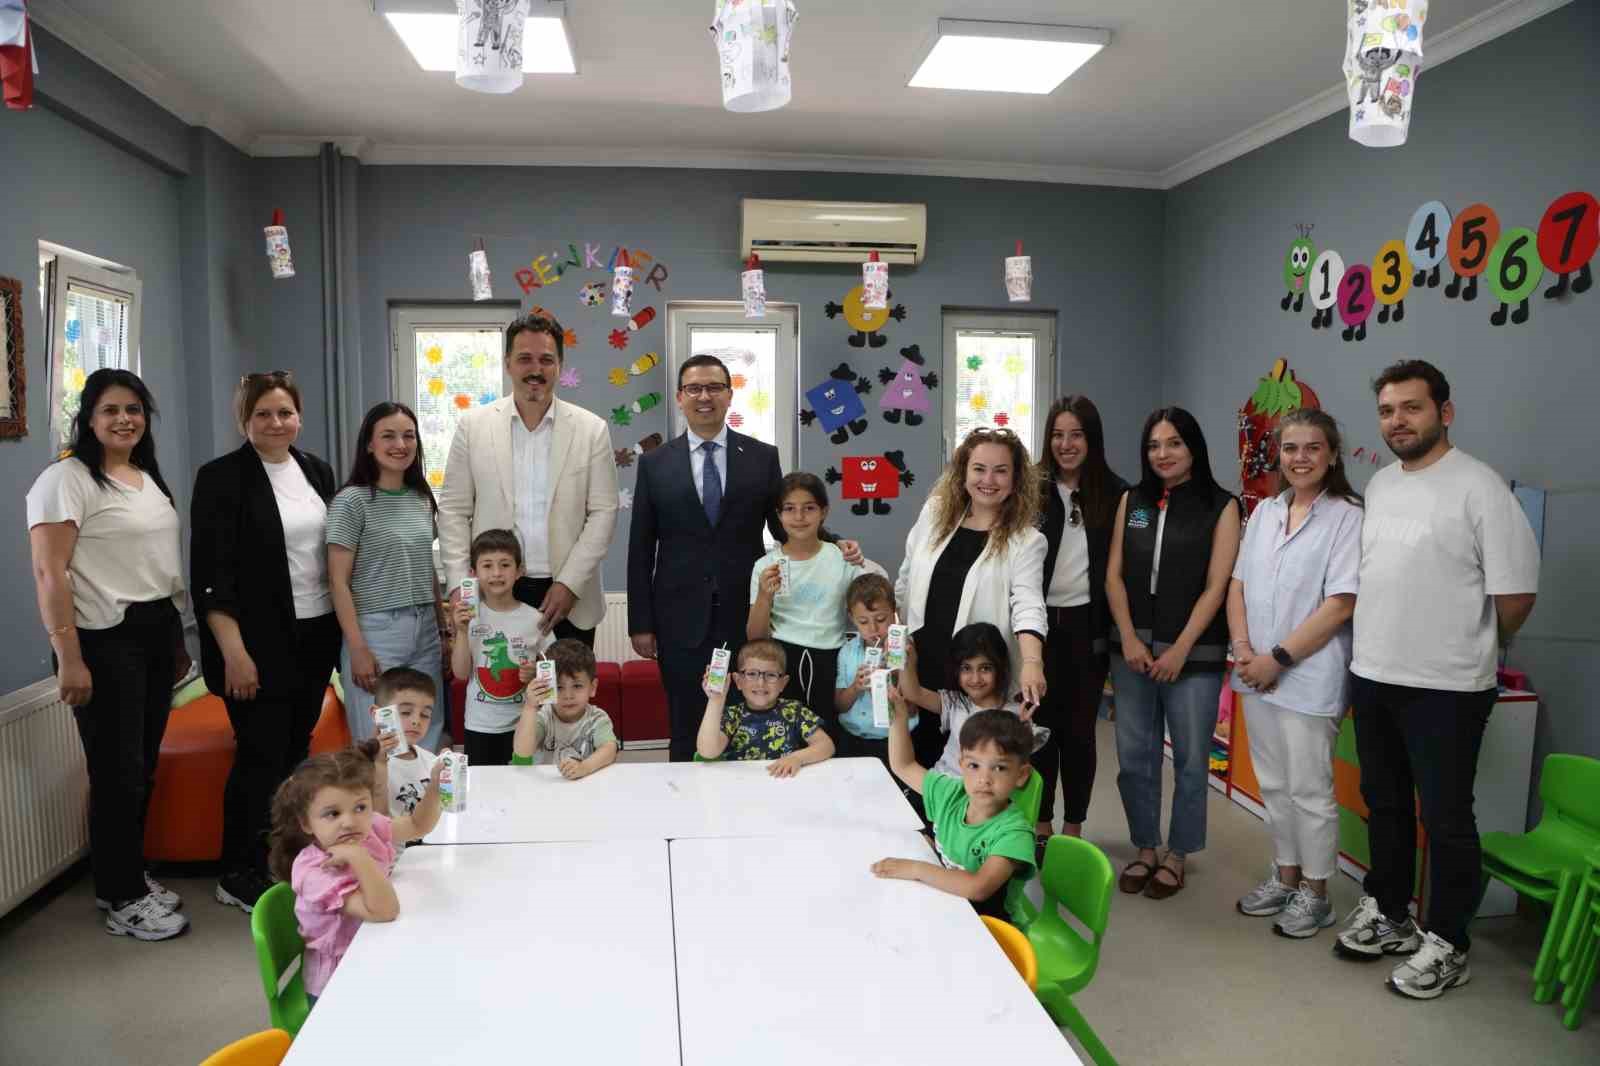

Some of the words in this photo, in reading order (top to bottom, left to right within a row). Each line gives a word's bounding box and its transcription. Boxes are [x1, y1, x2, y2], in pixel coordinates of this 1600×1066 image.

[1319, 259, 1331, 300] 1
[1346, 271, 1365, 314] 2
[1381, 250, 1402, 295] 3
[1414, 212, 1441, 258] 4
[1459, 216, 1488, 269] 5
[1499, 235, 1529, 291] 6
[1551, 203, 1588, 265] 7
